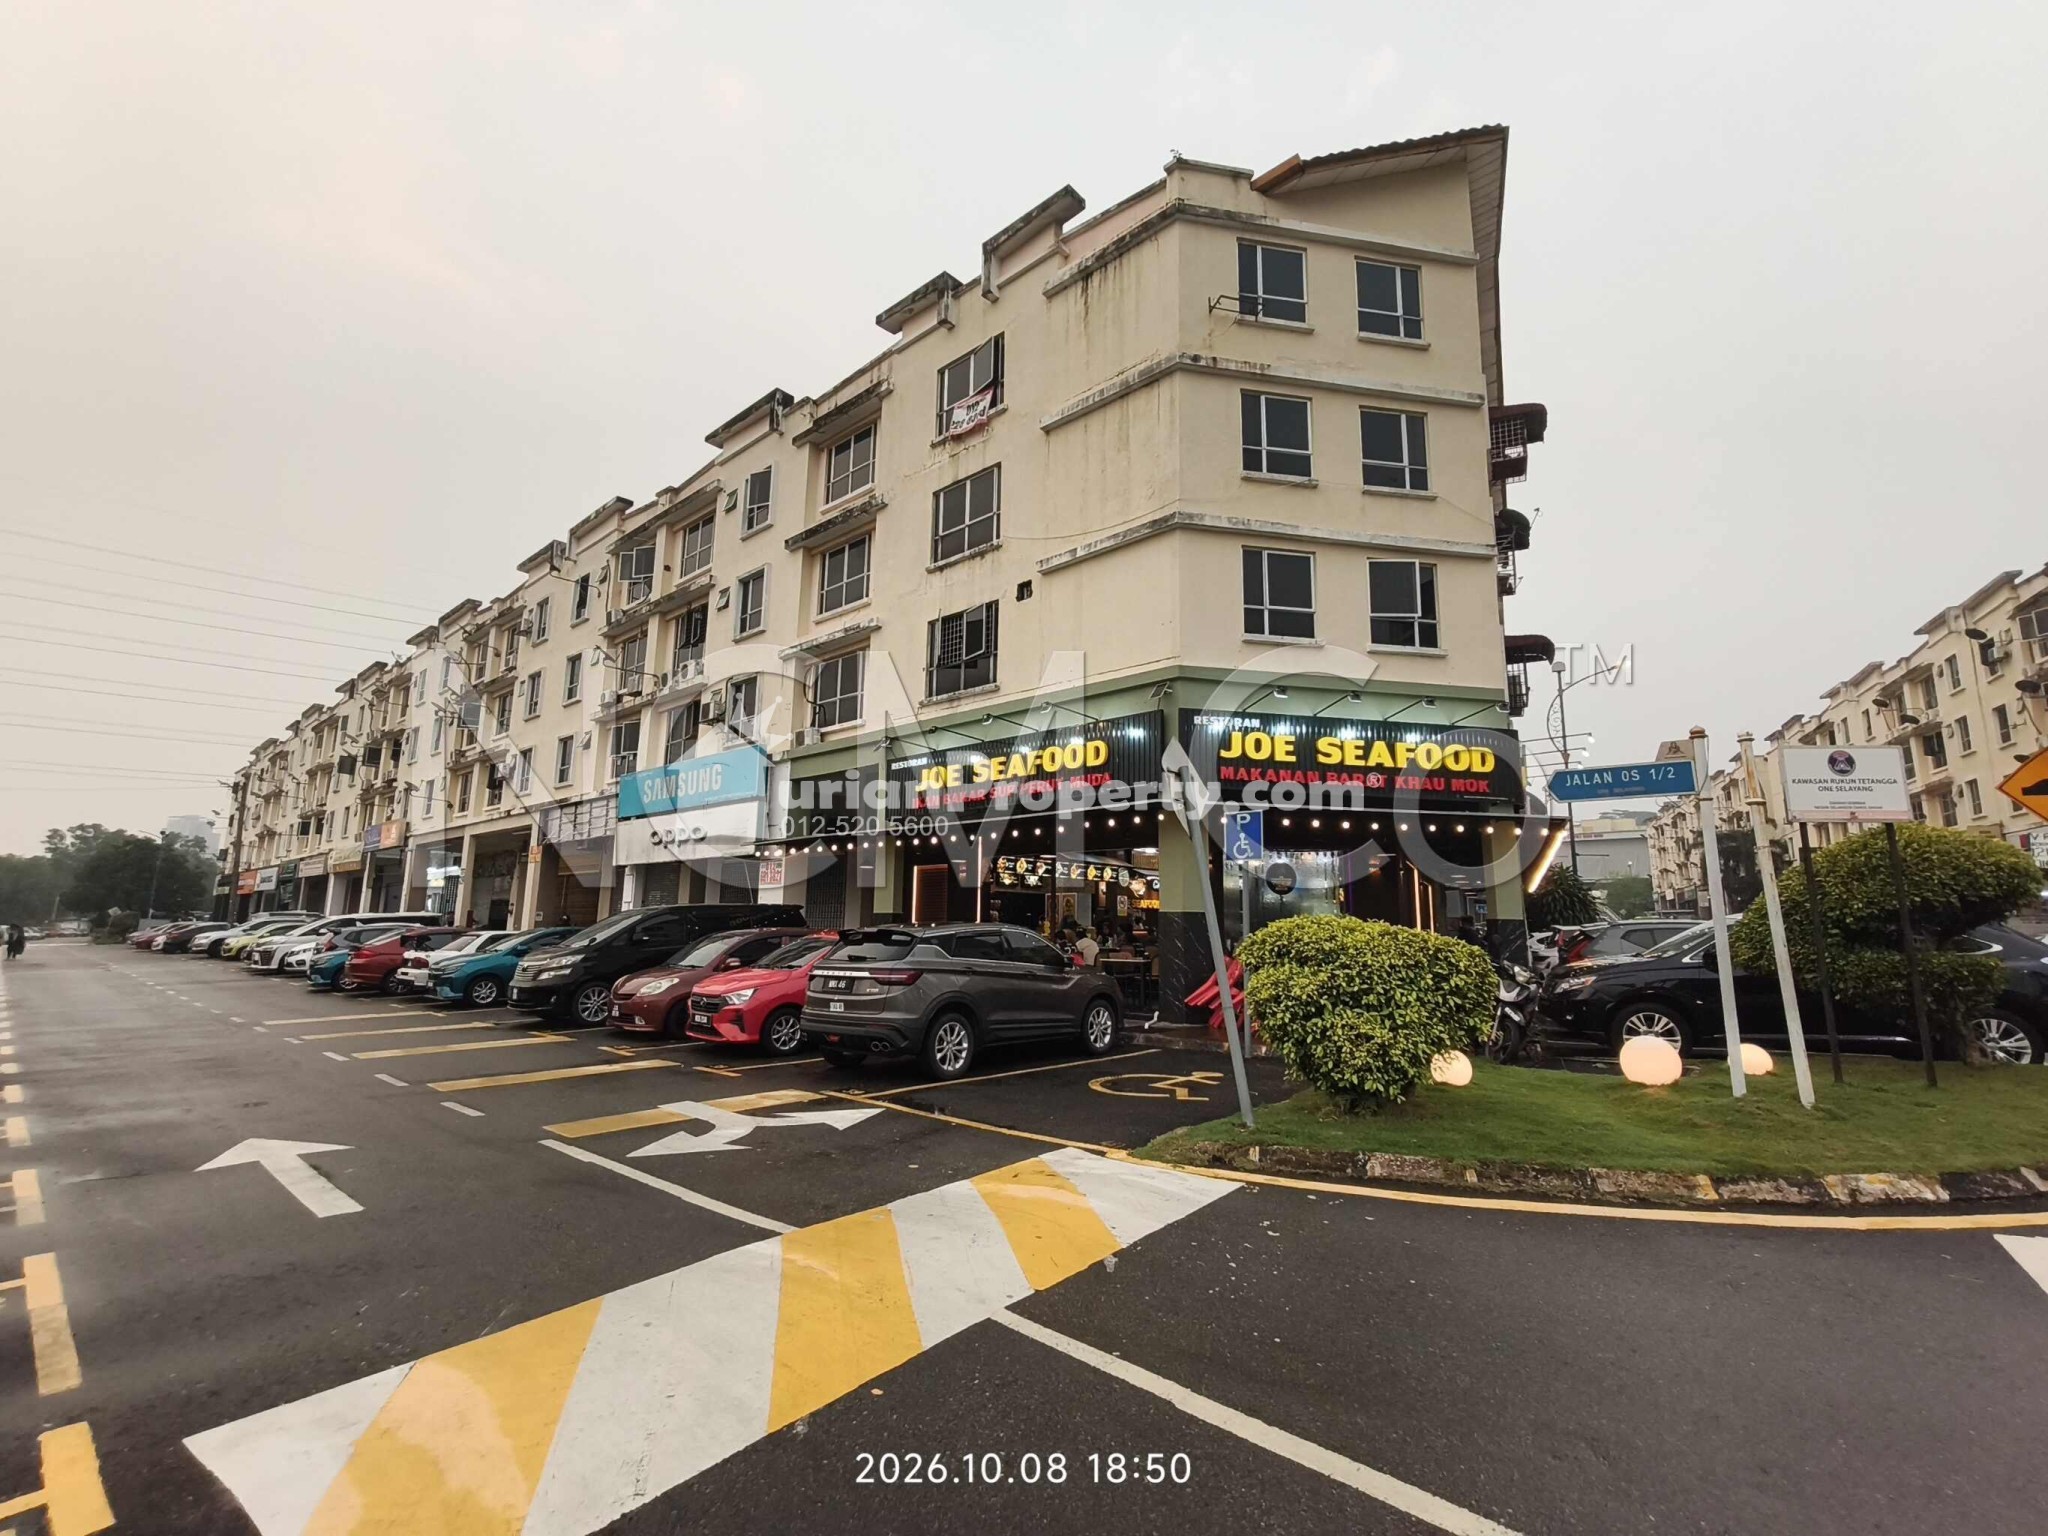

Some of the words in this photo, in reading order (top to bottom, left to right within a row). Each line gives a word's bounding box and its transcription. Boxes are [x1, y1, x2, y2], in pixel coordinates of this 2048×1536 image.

[1194, 715, 1260, 729] RESTORAN
[1219, 731, 1297, 763] JOE
[1316, 736, 1495, 773] SEAFOOD
[891, 757, 928, 771] RESTORAN
[914, 763, 963, 793] JOE
[973, 740, 1109, 783] SEAFOOD
[643, 763, 722, 804] SAMSUNG
[1070, 772, 1114, 789] MUDA
[1220, 766, 1320, 784] MAKANAN
[1395, 775, 1445, 791] KHAU
[1451, 778, 1490, 793] MOK
[1566, 770, 1613, 787] JALAN
[1649, 766, 1676, 781] 1/2
[1236, 814, 1251, 830] P
[650, 825, 707, 849] oppo
